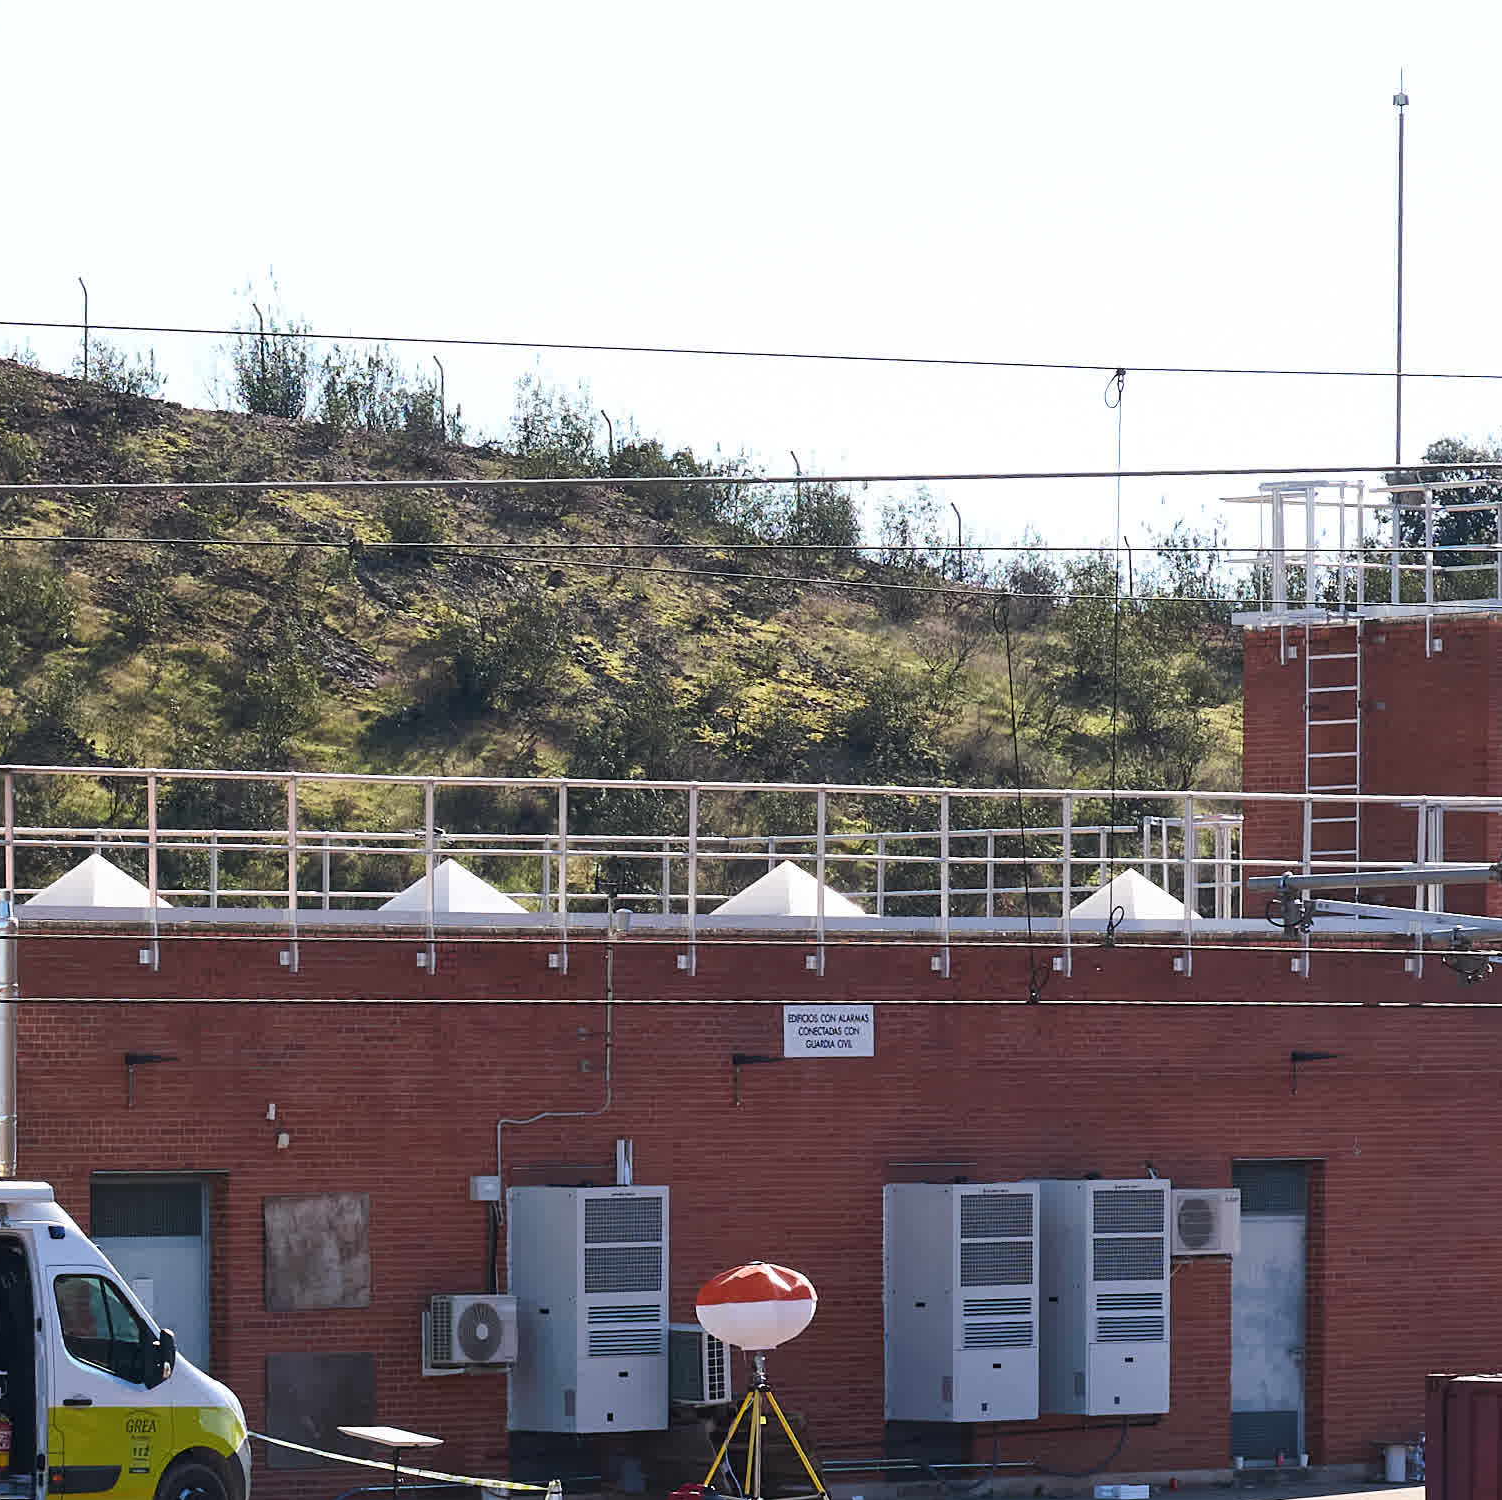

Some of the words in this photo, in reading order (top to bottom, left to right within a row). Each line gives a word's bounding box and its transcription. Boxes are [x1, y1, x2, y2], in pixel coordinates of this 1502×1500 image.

[787, 1014, 818, 1023] EDIFICIOS
[820, 1014, 836, 1023] CON
[838, 1014, 869, 1022] ALARMAS
[798, 1027, 842, 1036] CONECTADAS
[844, 1027, 860, 1035] CON
[805, 1040, 835, 1048] GUARDIA
[837, 1040, 853, 1048] CIVIL
[125, 1418, 157, 1433] GREA
